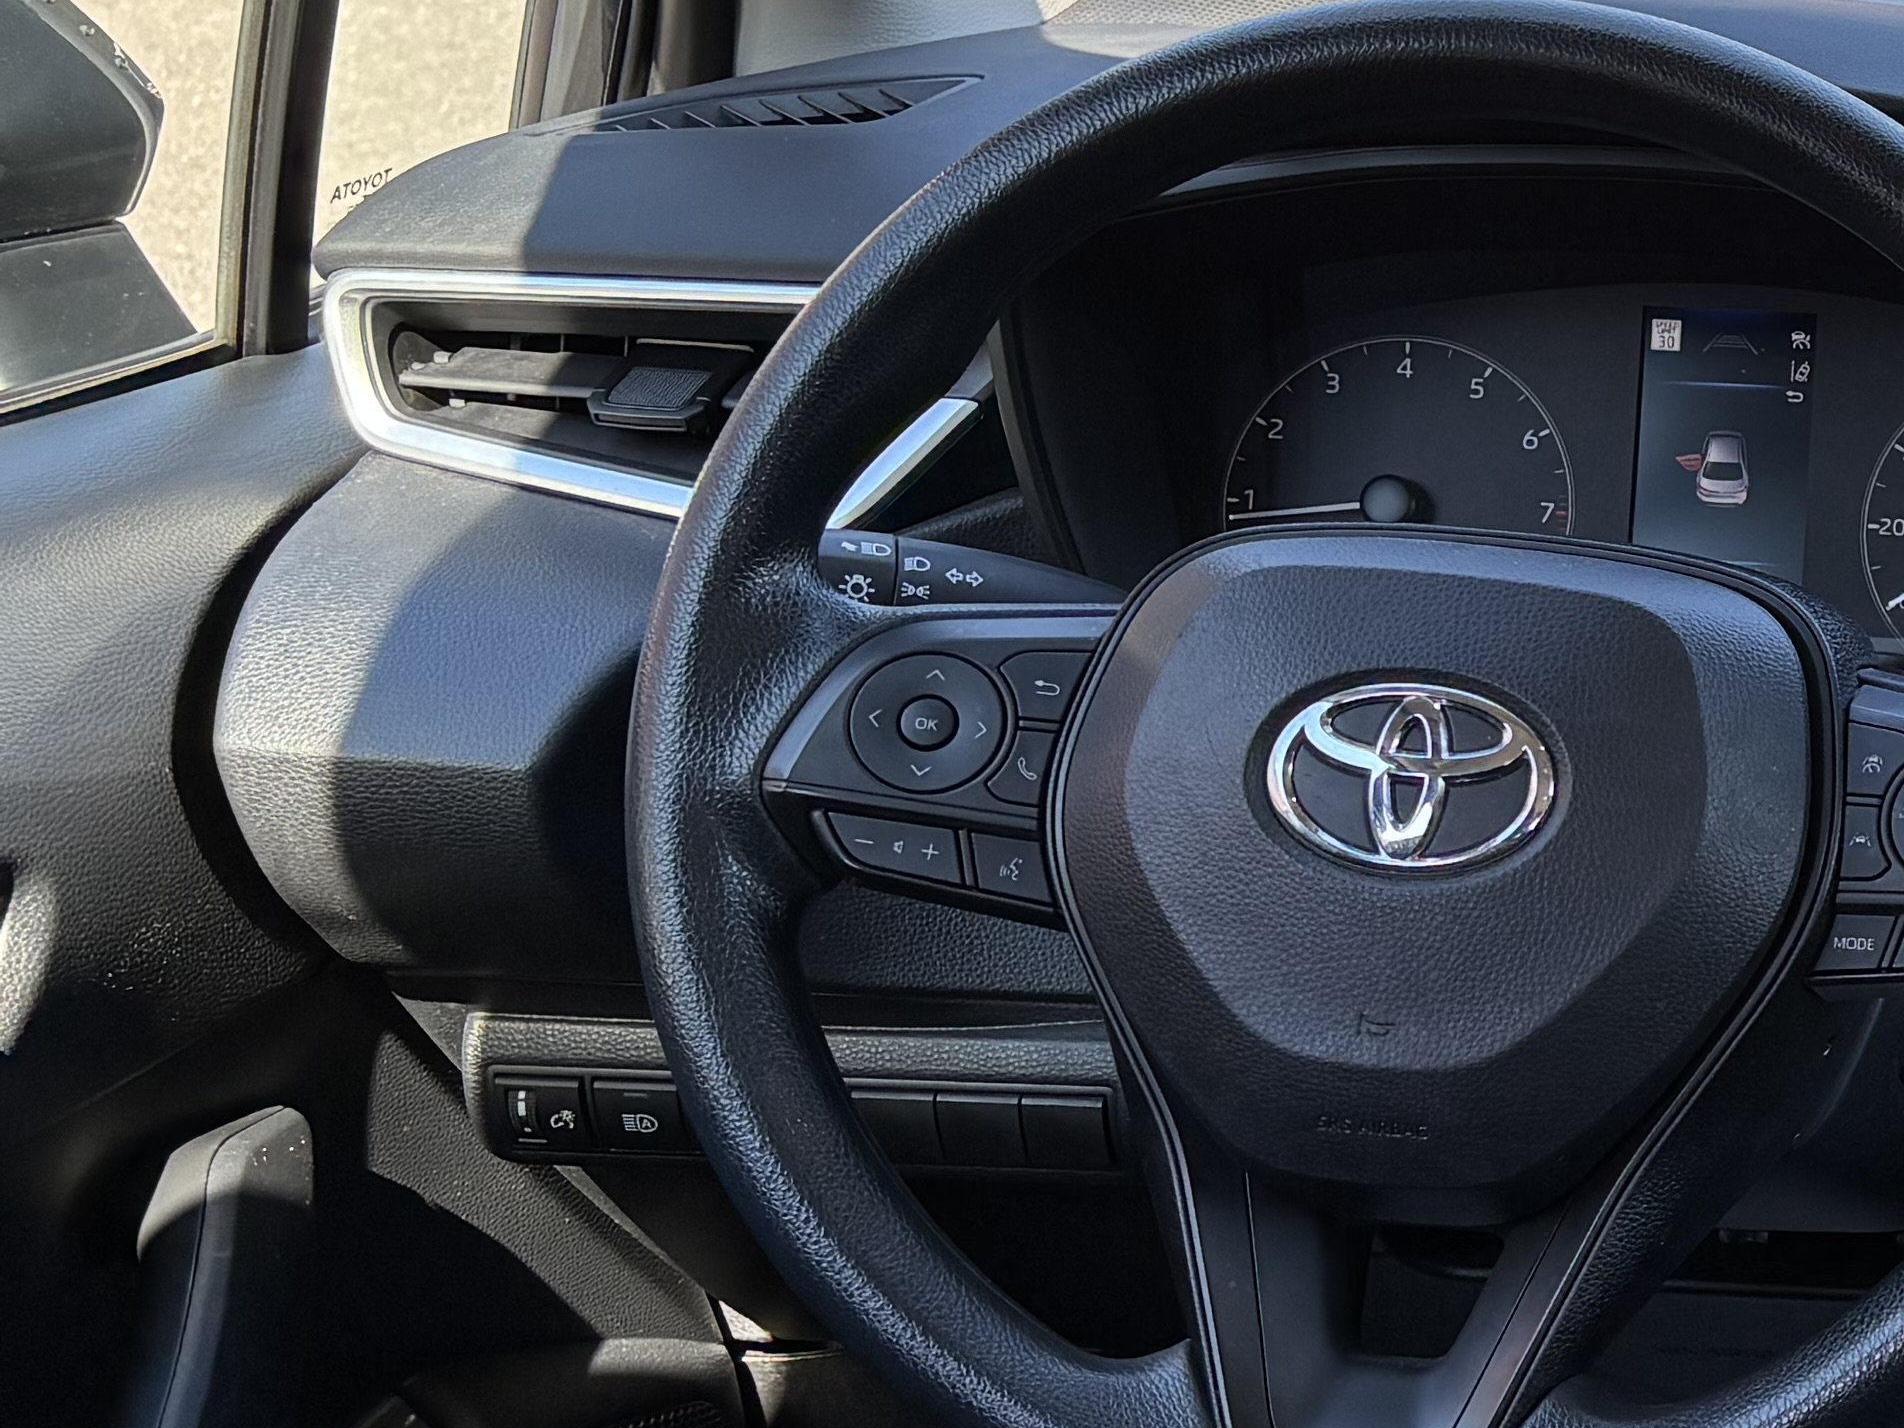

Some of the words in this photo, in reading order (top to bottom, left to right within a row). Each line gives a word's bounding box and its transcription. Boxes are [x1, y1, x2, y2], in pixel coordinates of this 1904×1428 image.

[1658, 336, 1675, 348] 30
[1397, 358, 1413, 378] 4
[1326, 373, 1340, 394] 3
[1470, 379, 1484, 399] 5
[1268, 419, 1284, 439] 2
[1523, 430, 1538, 450] 6
[1244, 489, 1254, 510] 1
[1540, 503, 1555, 523] 7
[915, 716, 938, 731] OK
[1833, 937, 1875, 951] MODE
